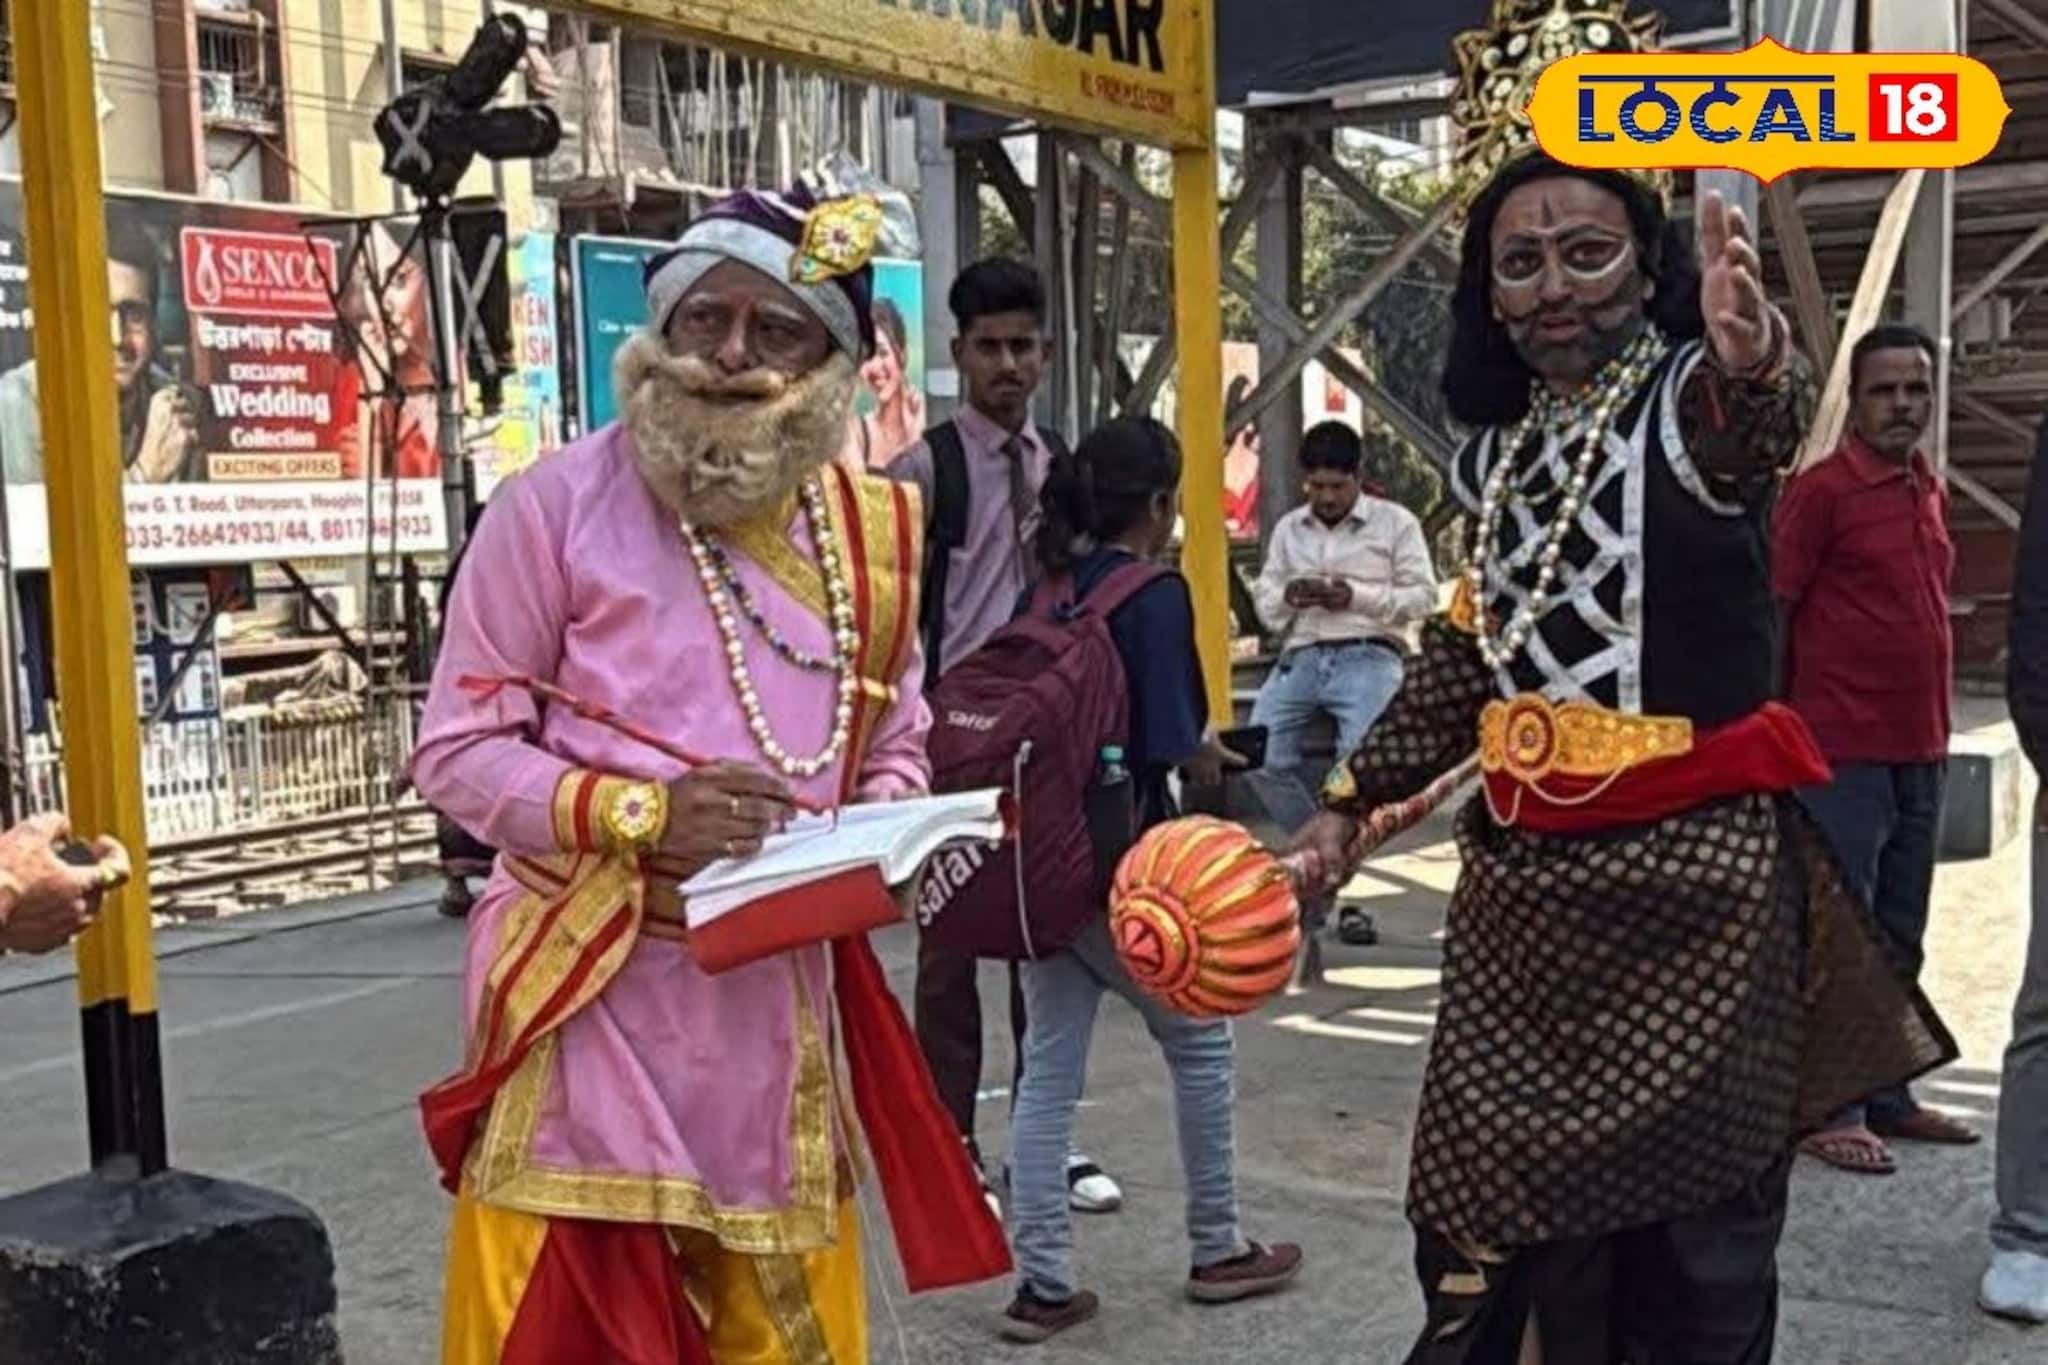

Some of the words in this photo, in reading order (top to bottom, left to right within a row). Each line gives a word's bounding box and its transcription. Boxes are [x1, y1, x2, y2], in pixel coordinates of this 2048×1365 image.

[221, 246, 327, 289] SENCO
[210, 383, 331, 424] Wedding
[229, 426, 317, 448] Collection
[213, 458, 283, 475] EXCITING
[285, 458, 337, 474] OFFERS
